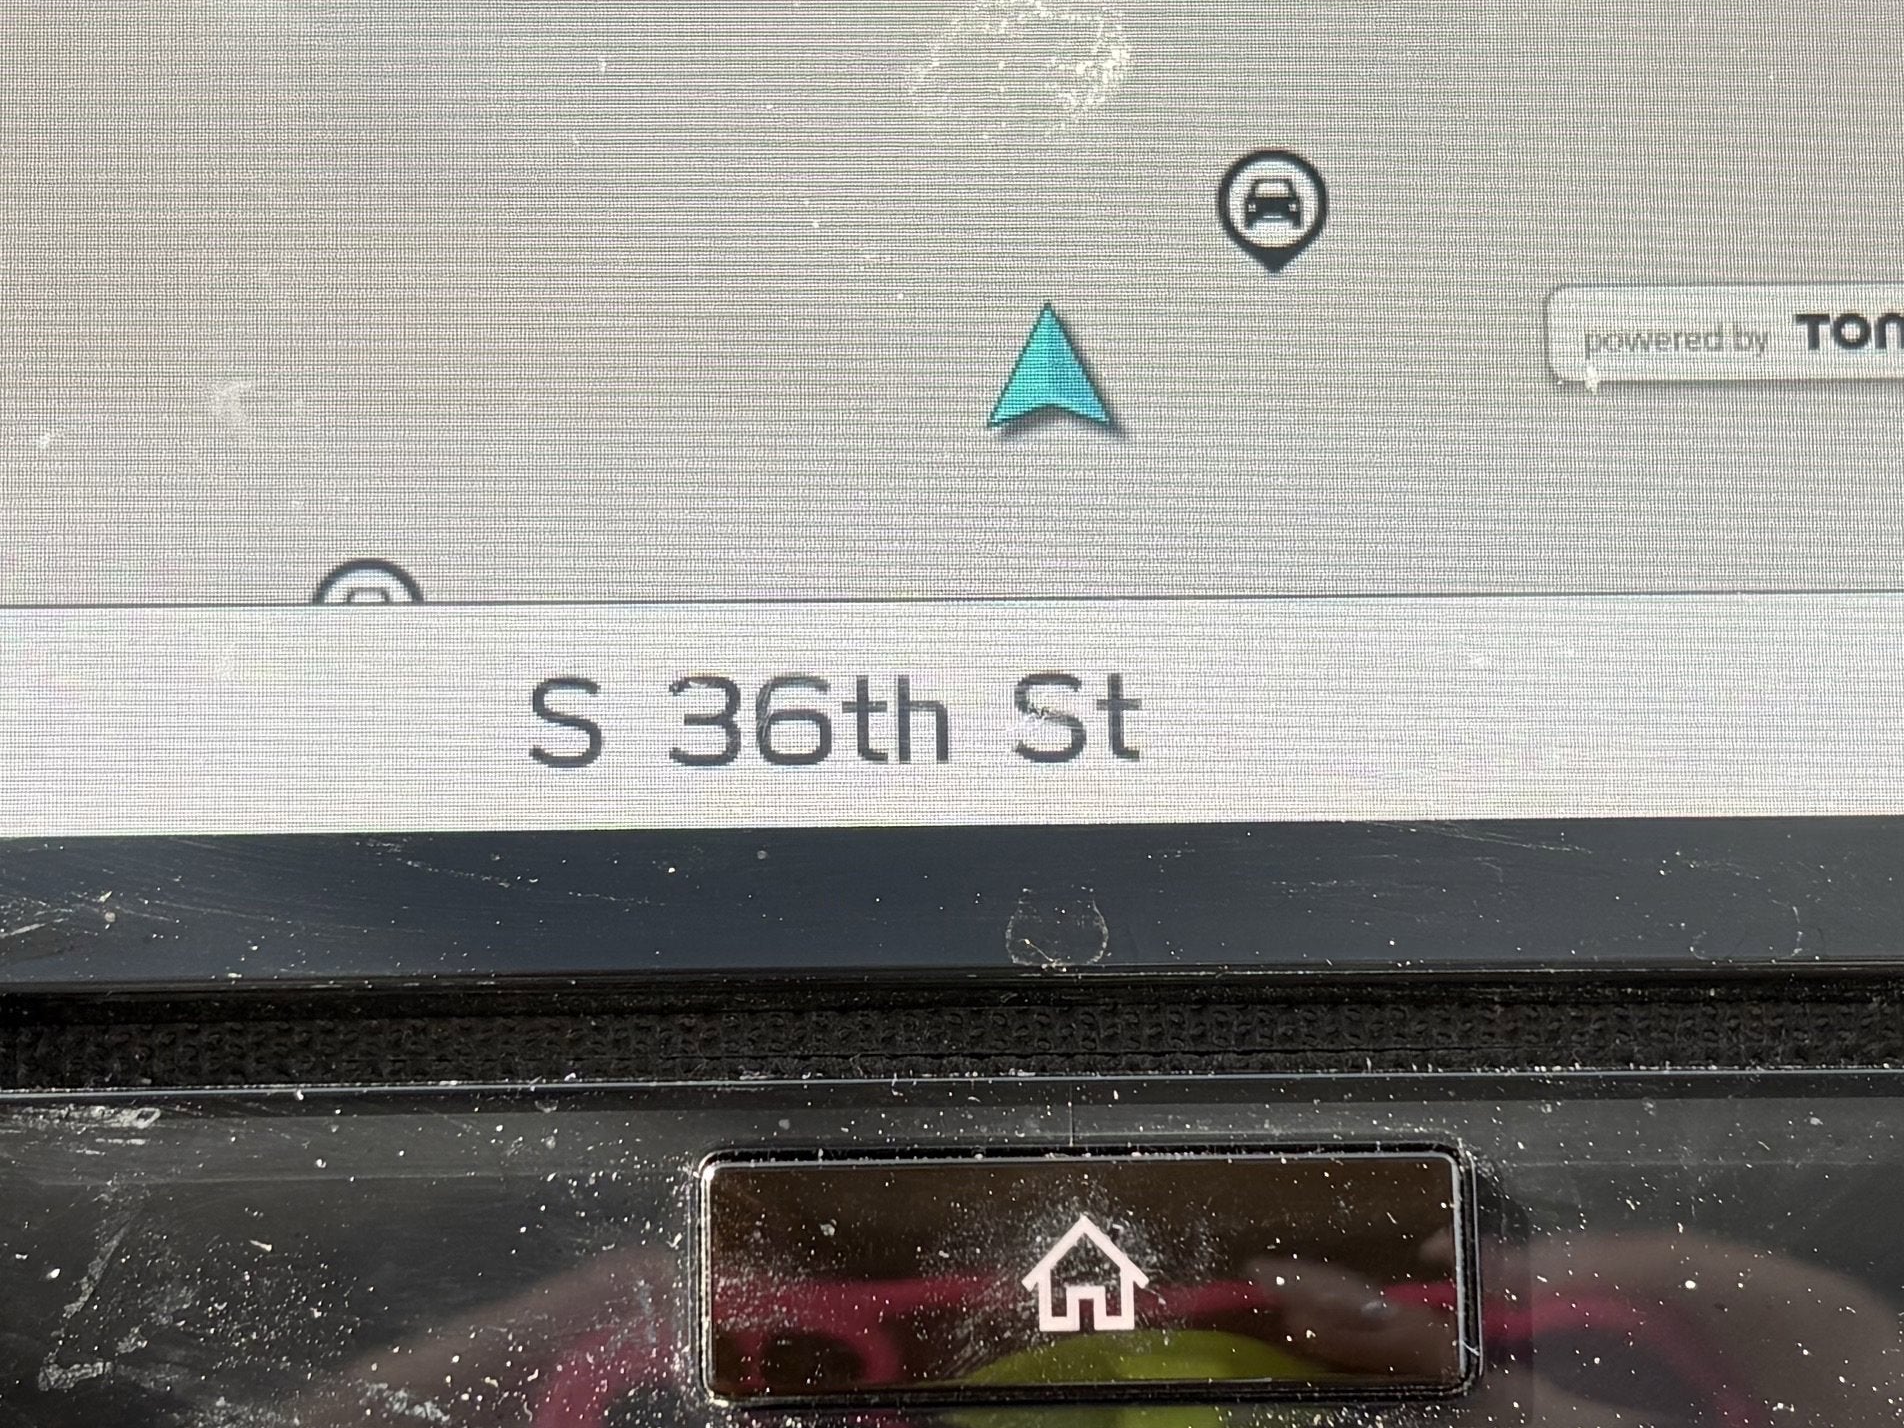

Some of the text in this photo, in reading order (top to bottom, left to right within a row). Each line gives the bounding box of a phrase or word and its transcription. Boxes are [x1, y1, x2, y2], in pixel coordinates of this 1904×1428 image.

[1585, 320, 1728, 360] powered
[1732, 319, 1769, 356] by
[528, 671, 1143, 769] S 36th St
